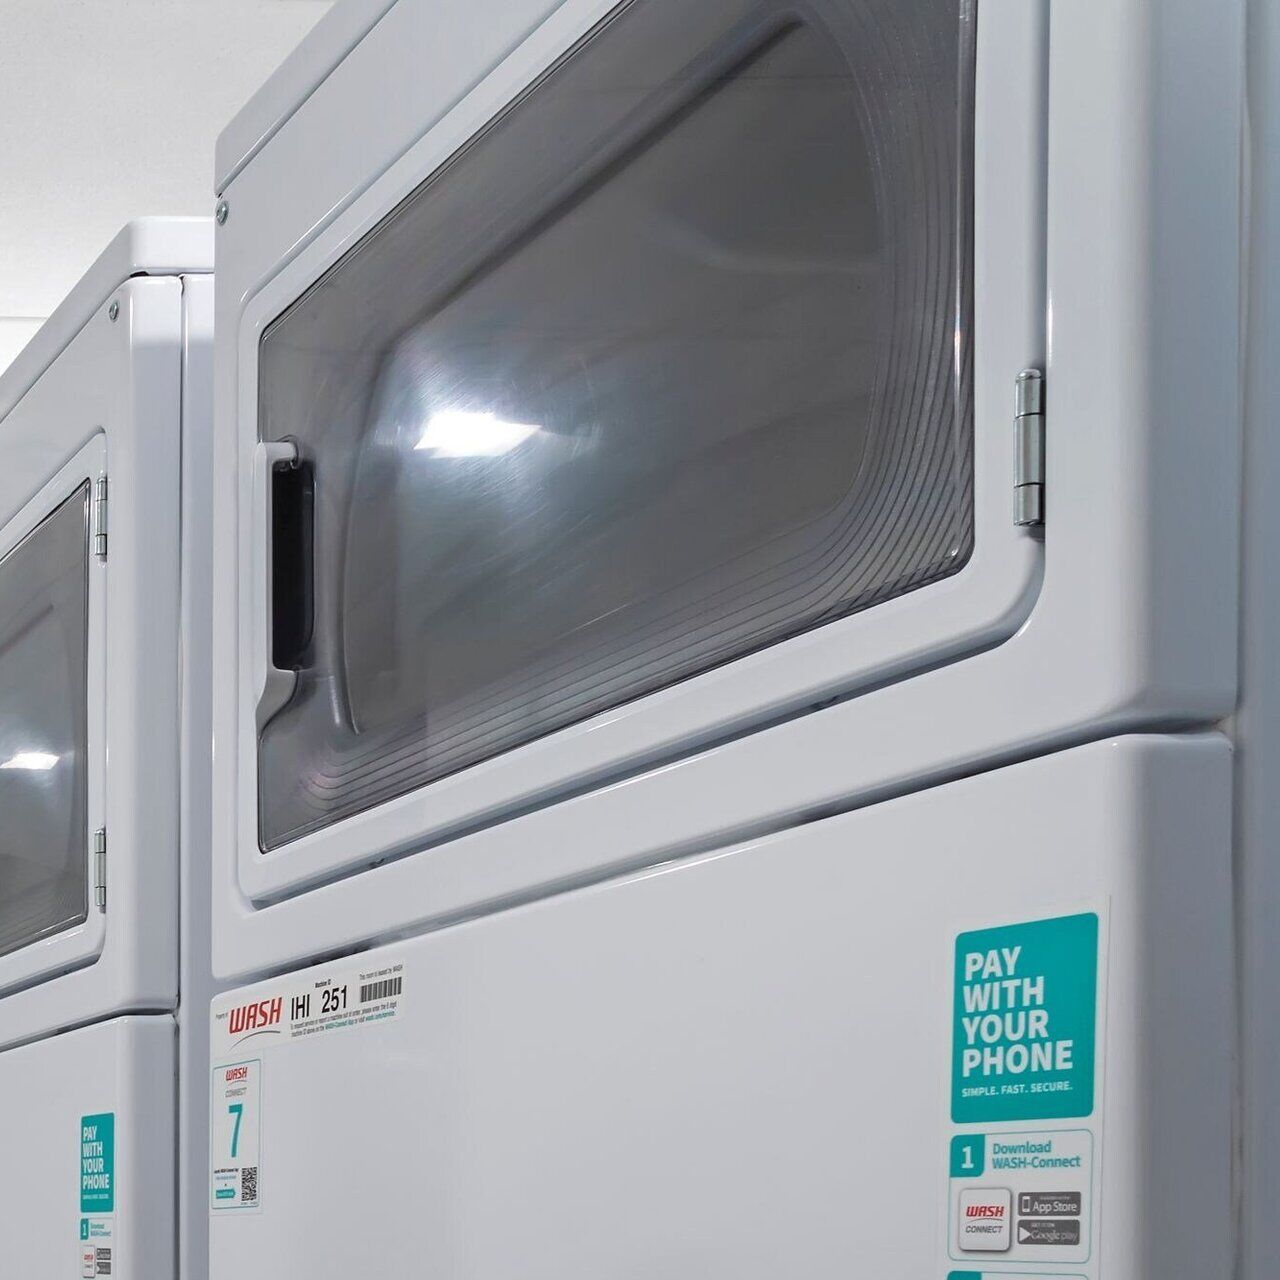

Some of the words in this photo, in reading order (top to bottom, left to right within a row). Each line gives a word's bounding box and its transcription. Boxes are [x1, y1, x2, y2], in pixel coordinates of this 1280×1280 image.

[965, 946, 1022, 981] PAY
[291, 994, 310, 1020] IHI
[322, 985, 347, 1013] 251
[963, 976, 1045, 1013] WITH
[229, 997, 283, 1034] WASH
[962, 1009, 1049, 1045] YOUR
[962, 1040, 1073, 1077] PHONE
[226, 1067, 248, 1081] WASH
[962, 1085, 999, 1098] SIMPLE.
[1001, 1084, 1028, 1095] FAST.
[1030, 1081, 1073, 1093] SECURE.
[83, 1125, 98, 1141] PAY
[228, 1103, 243, 1158] 7
[82, 1141, 103, 1158] WITH
[962, 1146, 974, 1169] 1
[992, 1140, 1052, 1154] Download
[82, 1158, 104, 1174] YOUR
[992, 1156, 1081, 1169] WASH-Connect
[82, 1174, 110, 1190] PHONE
[966, 1206, 1004, 1217] WASH
[1032, 1201, 1052, 1214] App
[1053, 1201, 1077, 1212] Store
[966, 1225, 1003, 1234] CONNECT
